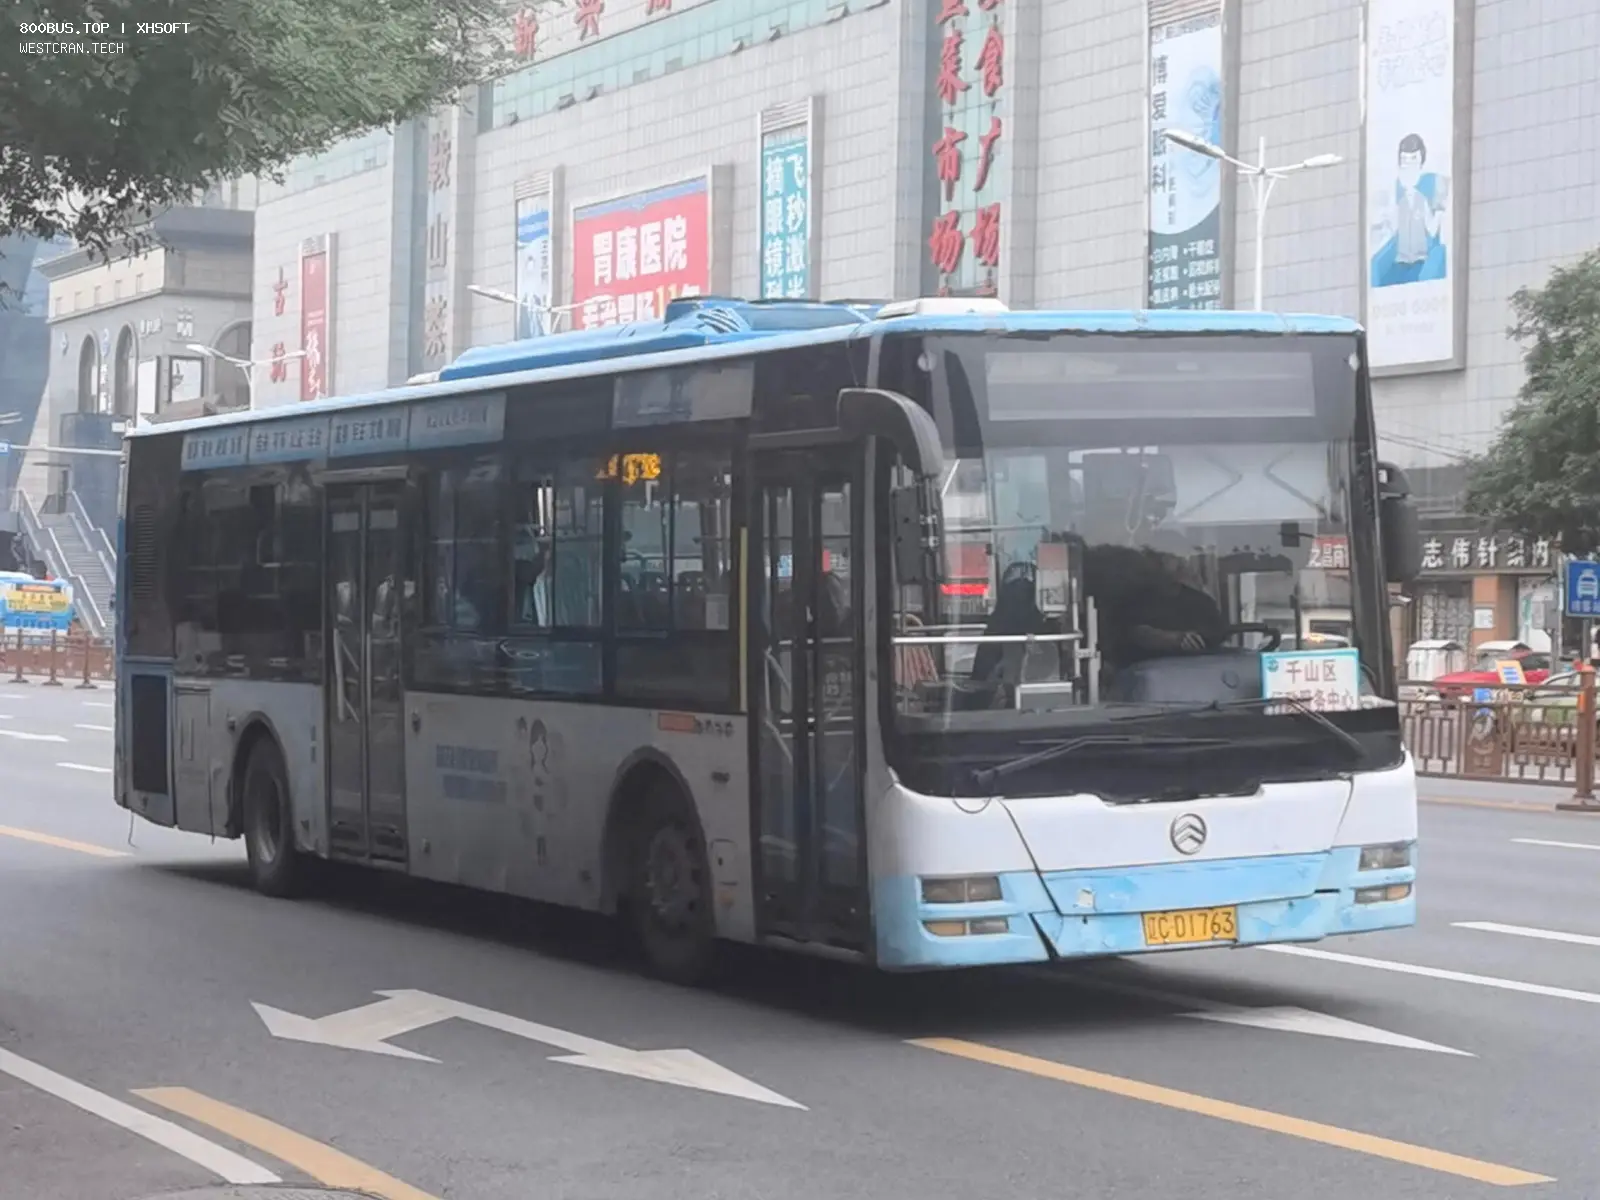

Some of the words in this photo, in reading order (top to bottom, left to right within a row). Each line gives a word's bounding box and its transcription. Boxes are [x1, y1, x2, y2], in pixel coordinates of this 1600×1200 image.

[929, 0, 967, 297] 菜市场
[971, 0, 1004, 297] 食广场
[592, 214, 688, 286] 胃康医院
[1285, 659, 1337, 684] 千山区
